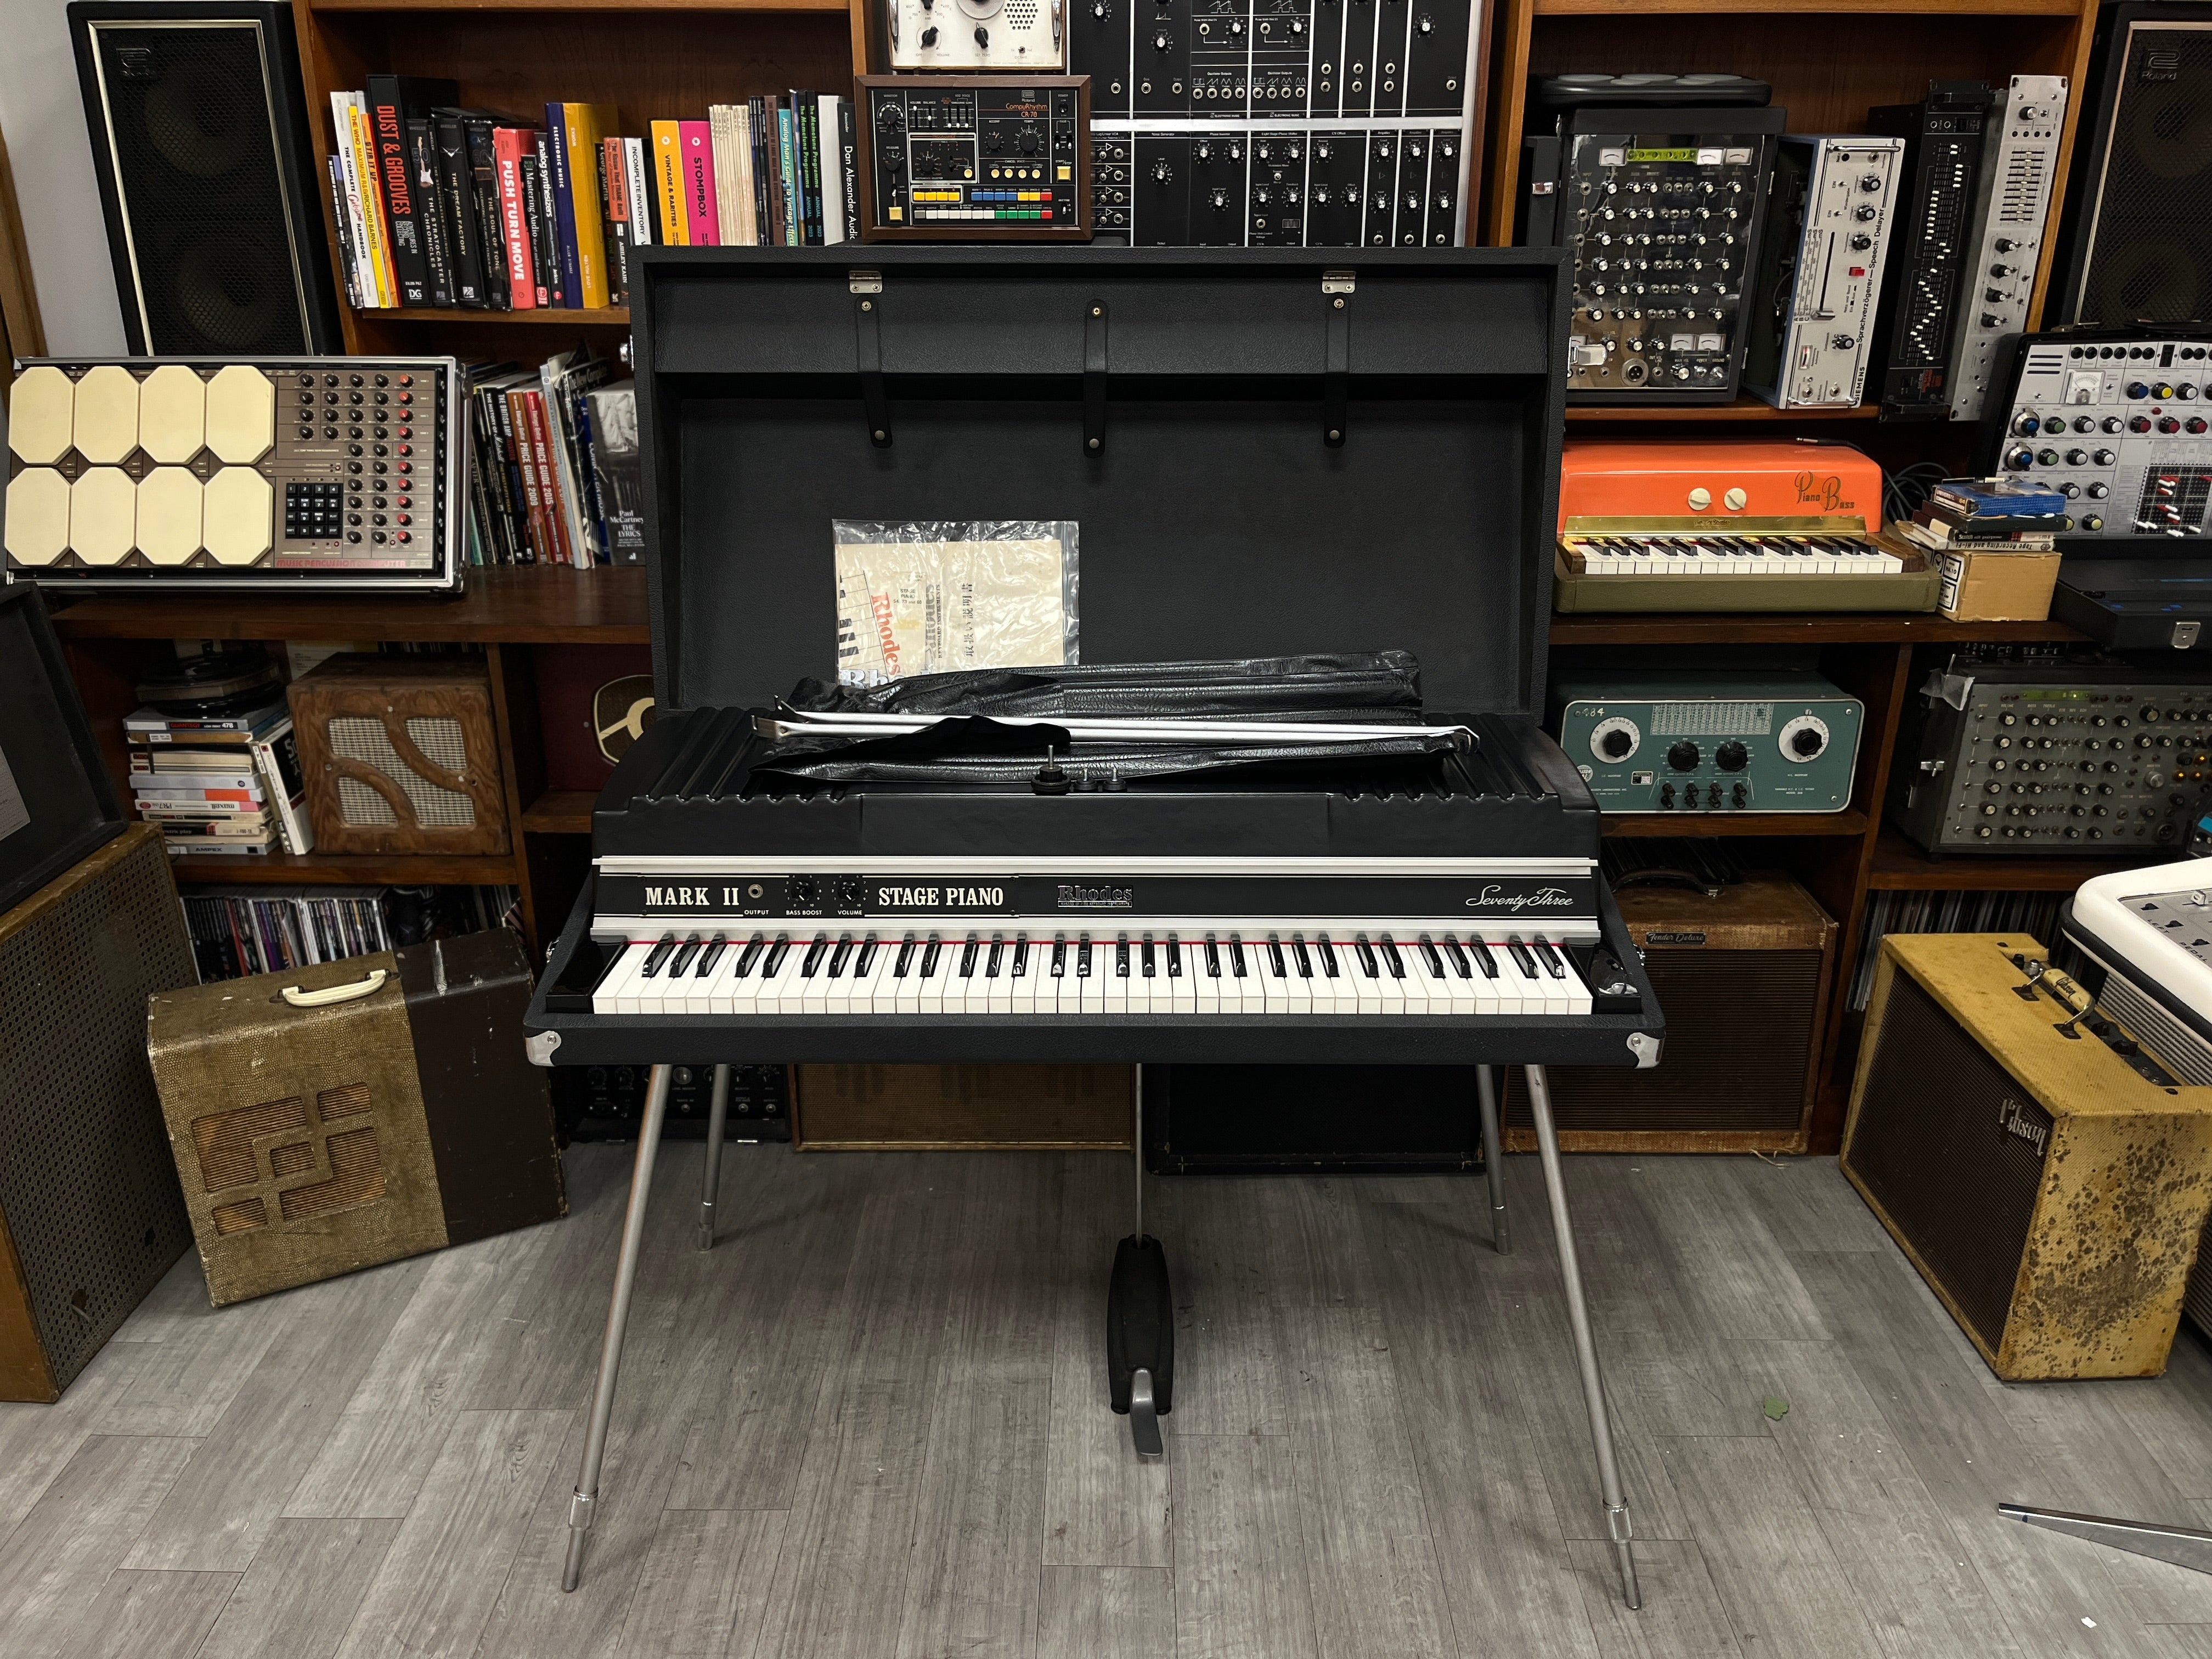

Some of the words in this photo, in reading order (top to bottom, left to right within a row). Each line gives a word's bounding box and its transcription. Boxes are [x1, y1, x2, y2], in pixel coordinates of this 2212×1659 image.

[2142, 70, 2177, 80] Roland
[377, 106, 400, 139] DUST
[383, 143, 400, 154] &
[412, 148, 431, 164] 50
[538, 141, 548, 168] analog
[554, 127, 562, 166] ELECTRONIC
[844, 146, 853, 165] Dan
[371, 172, 377, 182] UP
[503, 161, 516, 198] PUSH
[632, 146, 641, 193] INCOMPLETE
[665, 155, 673, 187] VINTAGE
[356, 148, 368, 180] MAXIMUM
[369, 224, 377, 250] BARNES
[385, 157, 411, 215] GROOVES
[540, 170, 552, 218] synthesizers
[694, 157, 707, 217] STOMPBOX
[846, 167, 856, 213] Alexander
[347, 161, 356, 191] COMPLETE
[357, 223, 366, 259] HANDBOOK
[526, 172, 536, 212] Mastering
[531, 216, 539, 237] Audio
[636, 194, 646, 235] INVENTORY
[507, 202, 520, 239] TURN
[425, 213, 436, 268] CHRONICLES
[431, 218, 445, 284] STRATOCASTER
[458, 220, 466, 256] FACTORY
[493, 238, 498, 247] OF
[511, 242, 525, 280] MOVE
[1857, 279, 1872, 343] Sprachverzögerer
[1869, 240, 1879, 269] Speech
[1874, 209, 1884, 237] Delayer
[408, 289, 422, 298] DG
[1854, 366, 1865, 401] SIEMENS
[488, 405, 496, 426] HISTORY
[493, 426, 498, 435] OF
[500, 404, 509, 424] BRITISH
[504, 425, 512, 437] AMP
[520, 443, 531, 463] PRICE
[535, 443, 546, 463] PRICE
[524, 465, 535, 486] GUIDE
[540, 465, 550, 486] GUIDE
[528, 488, 538, 506] 2009
[543, 487, 554, 505] 2015
[1795, 471, 1821, 505] Piano
[1822, 476, 1855, 512] Bass
[1987, 541, 2017, 550] Recording
[276, 559, 303, 567] MUSIC
[305, 559, 355, 567] PERCUSSION
[871, 592, 901, 675] Rhodes
[645, 888, 710, 906] MARK
[723, 888, 739, 906] II
[879, 887, 939, 906] STAGE
[946, 887, 1003, 906] PIANO
[1058, 885, 1132, 901] Rhodes
[1465, 885, 1528, 912] Seventy
[1527, 887, 1573, 906] Three
[1648, 933, 1674, 942] Fender
[1675, 933, 1704, 942] Deluxe
[2147, 919, 2170, 933] LEFT
[2179, 942, 2208, 962] PEDAL
[2055, 977, 2076, 997] Gibson
[1999, 1098, 2046, 1156] Gibson
